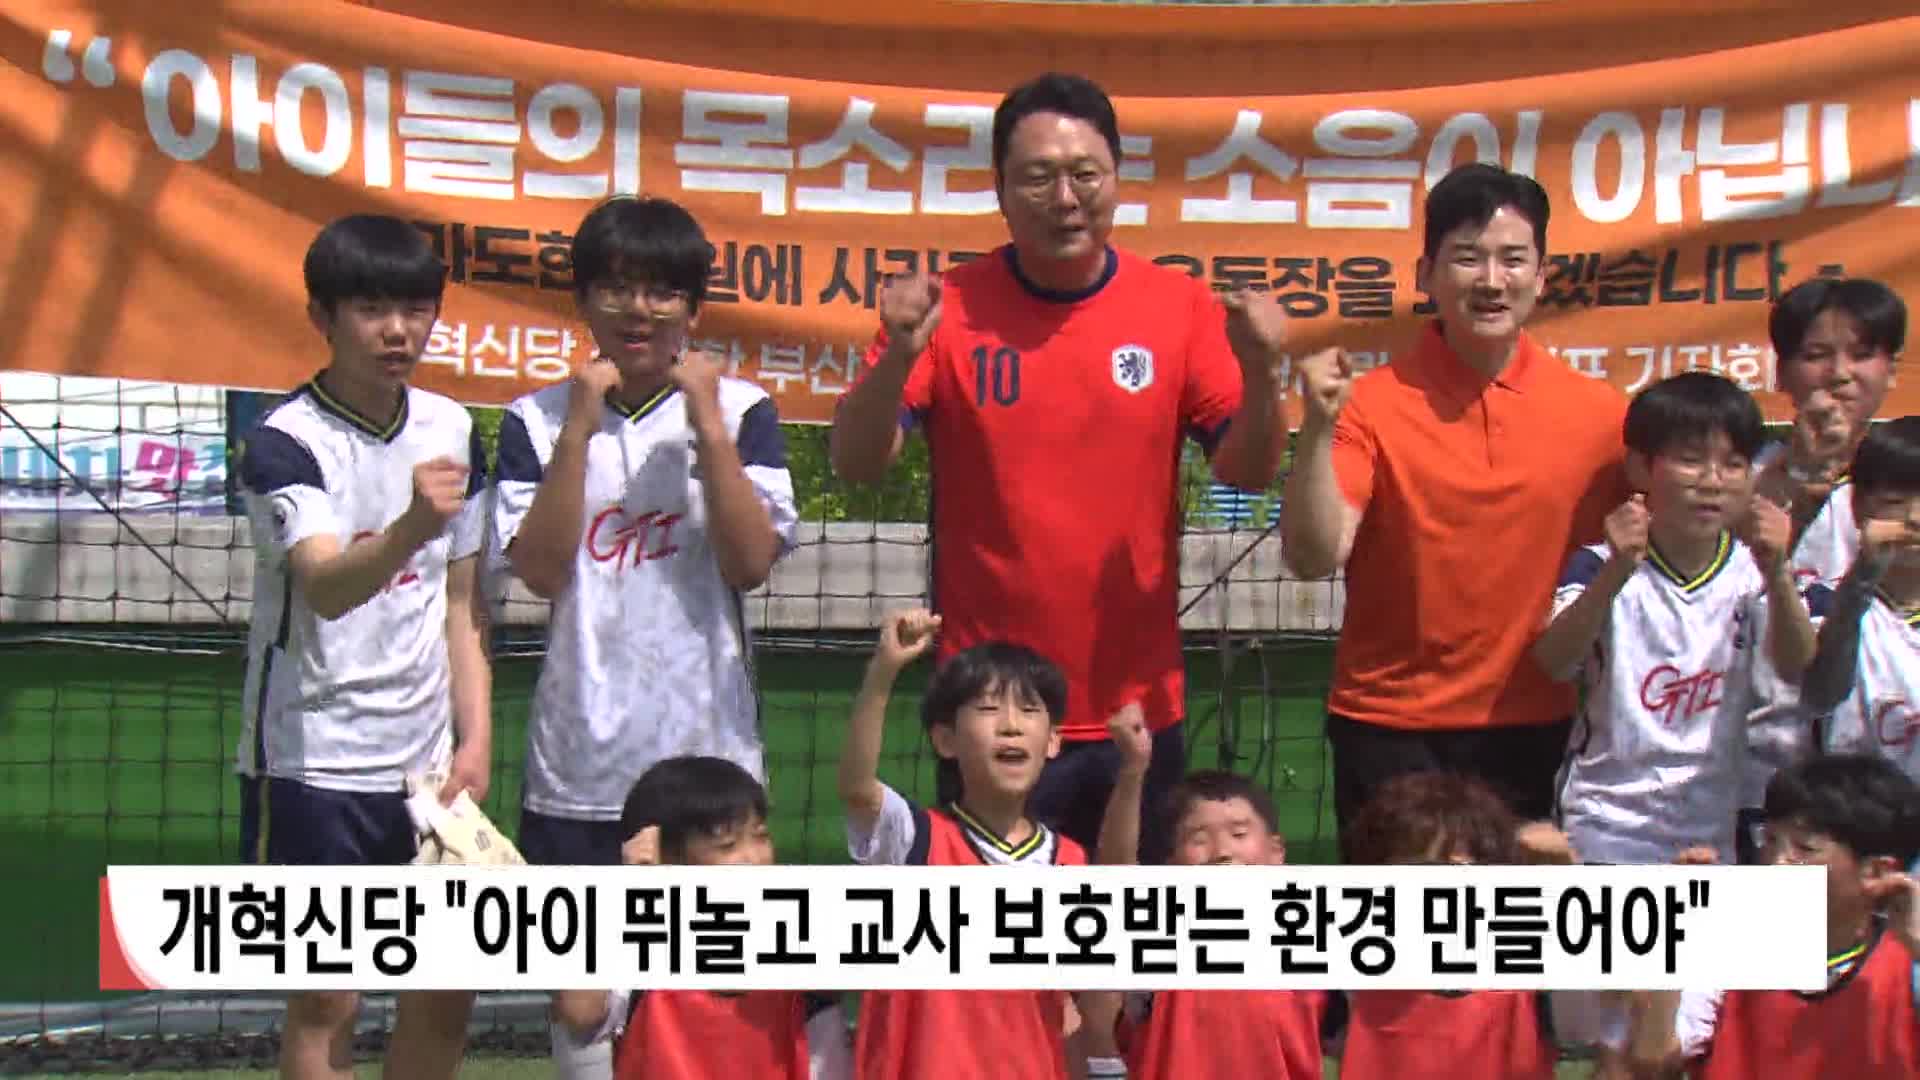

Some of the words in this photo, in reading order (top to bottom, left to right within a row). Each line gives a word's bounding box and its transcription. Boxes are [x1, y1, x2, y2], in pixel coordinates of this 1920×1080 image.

[420, 318, 577, 381] 혁신당
[971, 346, 1020, 406] 10
[587, 507, 683, 573] GTI
[1640, 665, 1727, 724] GTI
